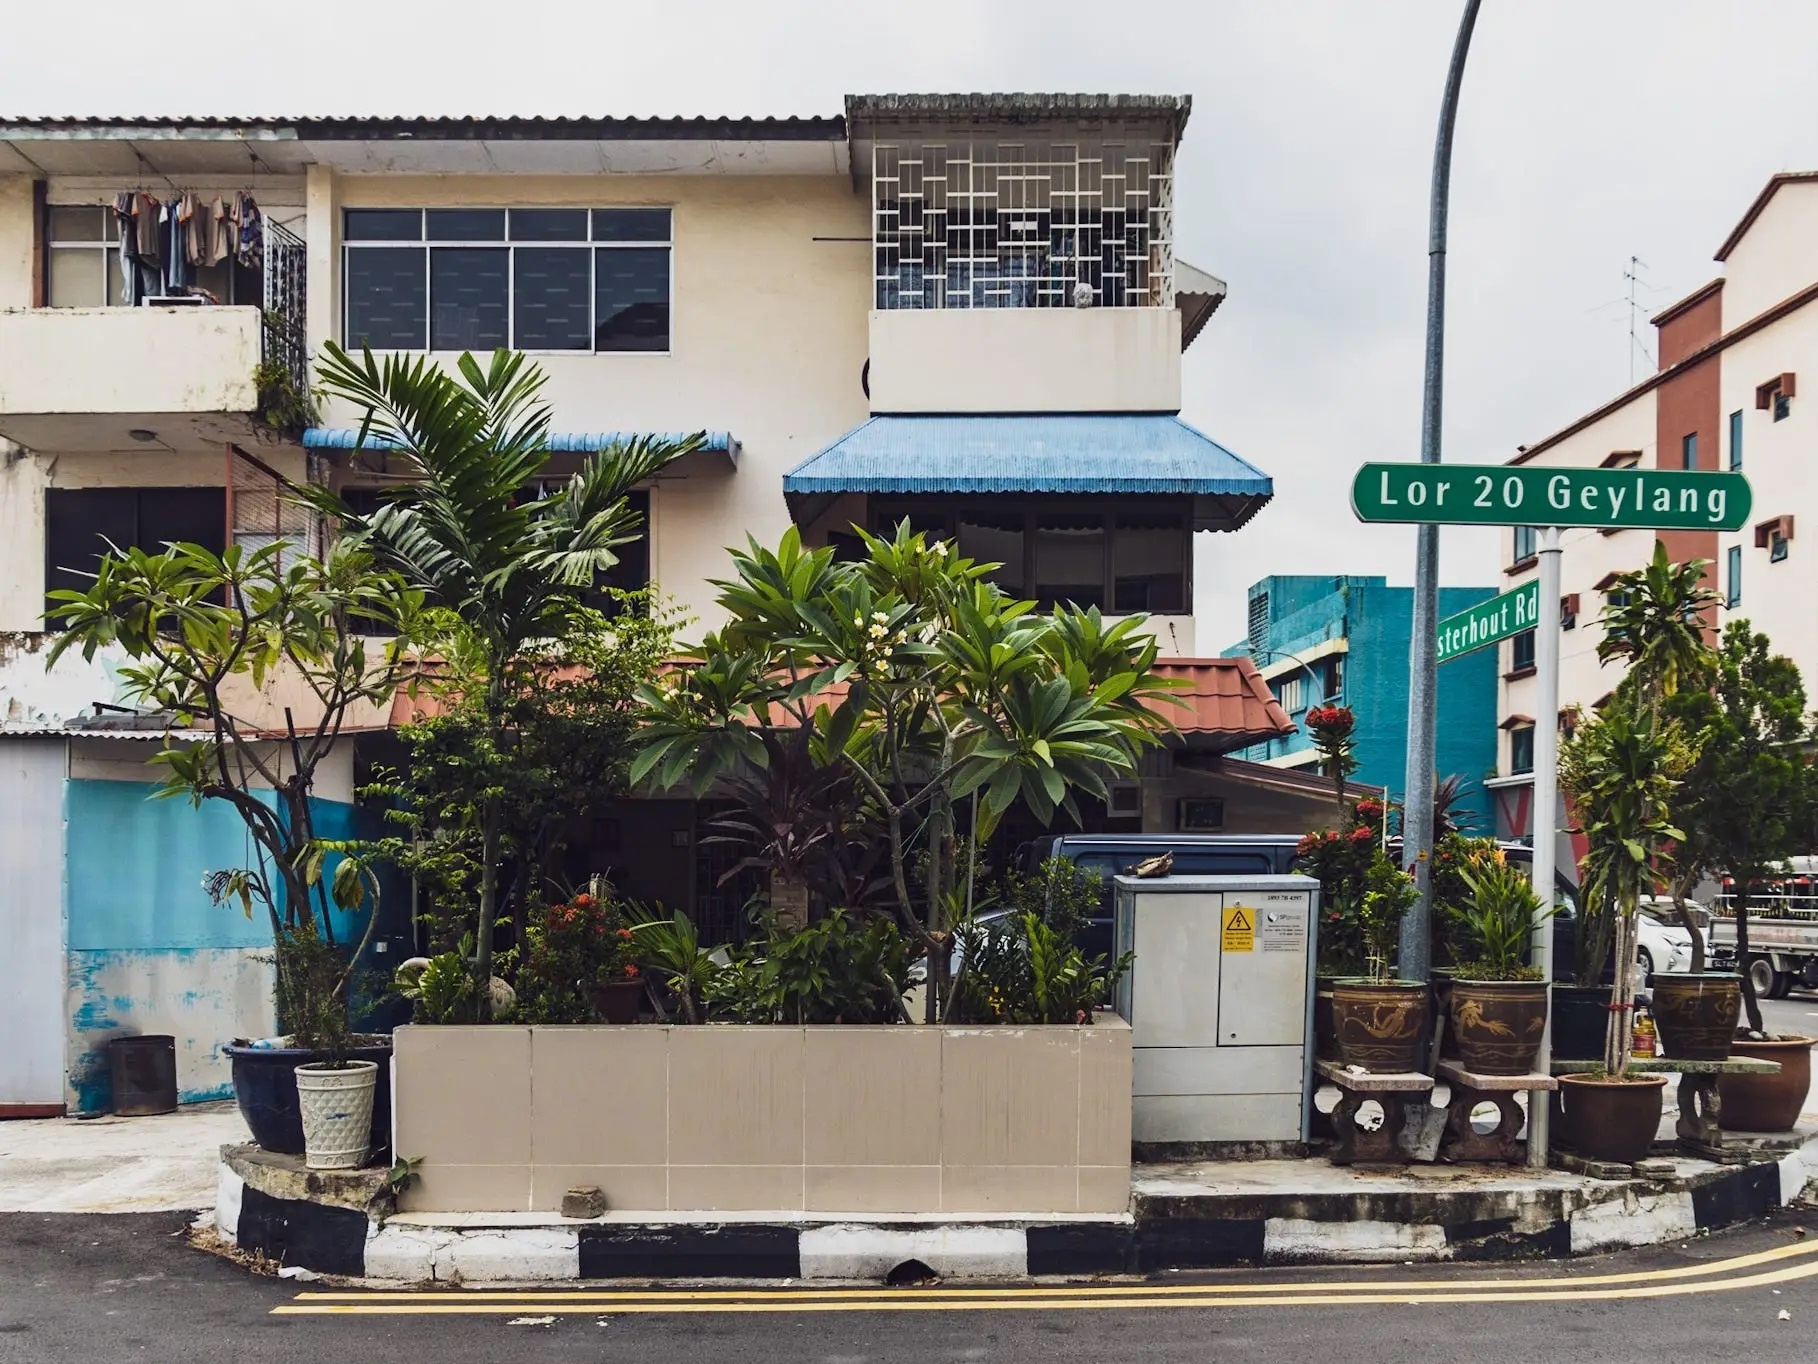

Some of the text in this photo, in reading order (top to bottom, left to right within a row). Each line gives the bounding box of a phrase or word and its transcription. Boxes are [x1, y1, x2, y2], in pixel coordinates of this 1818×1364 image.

[1381, 471, 1727, 522] Lor 20 Geylang
[1516, 588, 1537, 626] Rd
